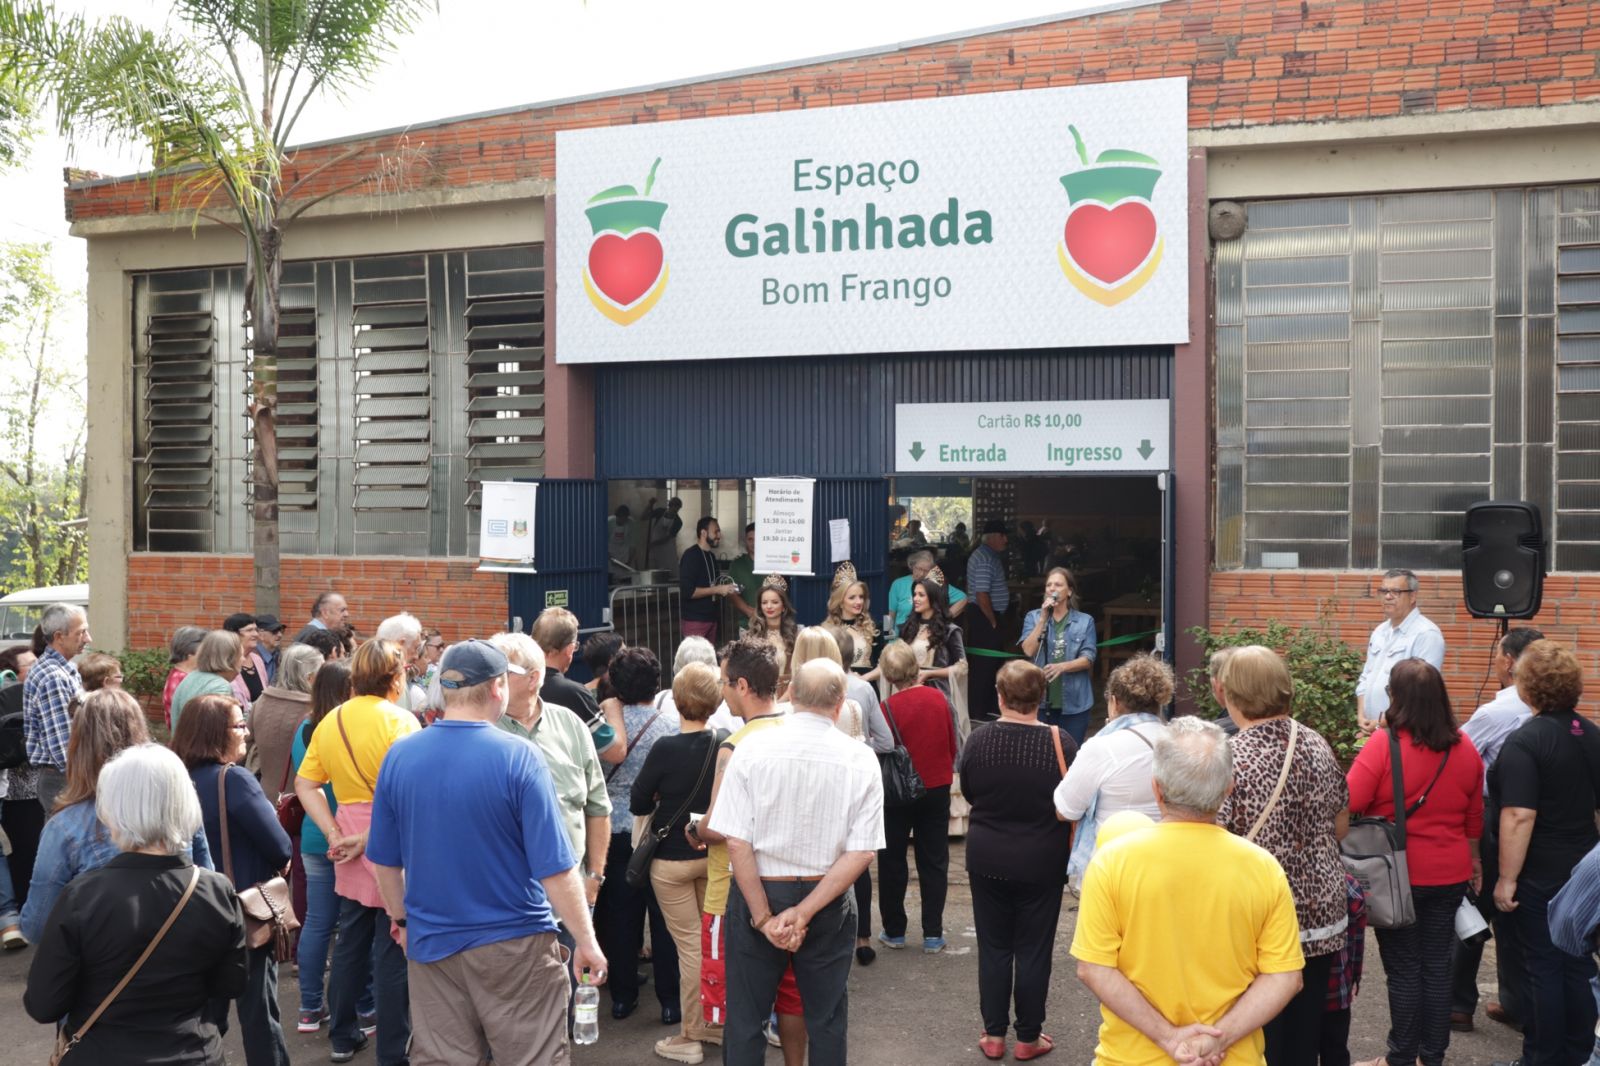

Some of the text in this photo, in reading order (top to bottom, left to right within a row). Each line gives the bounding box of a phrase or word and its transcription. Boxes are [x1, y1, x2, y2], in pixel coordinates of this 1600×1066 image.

[793, 157, 920, 195] Espaço
[724, 197, 994, 258] Galinhada
[762, 273, 952, 307] Bom Frango
[977, 413, 1082, 430] Cartão R$ 10,00
[939, 443, 1007, 463] Entrada
[1047, 443, 1123, 466] Ingresso
[773, 509, 795, 517] Almoço
